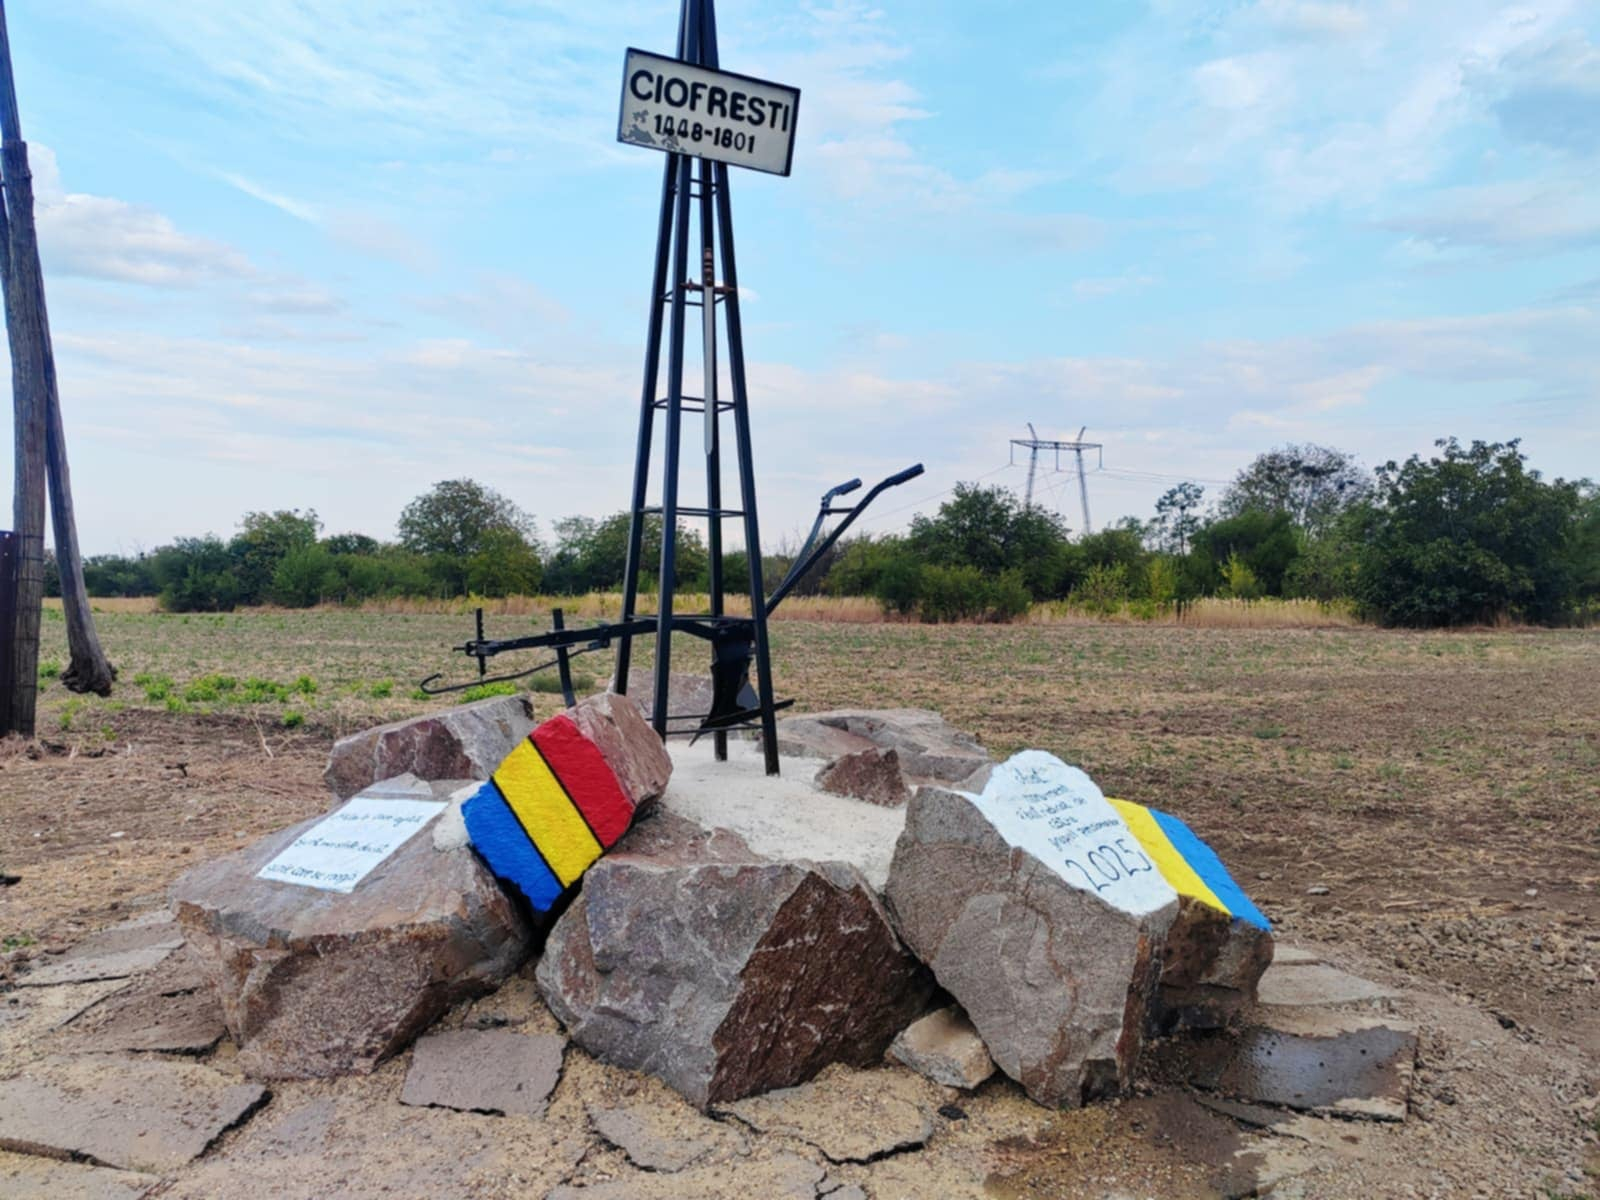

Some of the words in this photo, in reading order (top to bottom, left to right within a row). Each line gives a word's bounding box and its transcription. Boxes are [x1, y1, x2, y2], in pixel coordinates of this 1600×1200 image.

[630, 70, 789, 132] CIOFRESTI
[654, 114, 756, 154] 1448-1801
[1065, 838, 1152, 892] 2025
